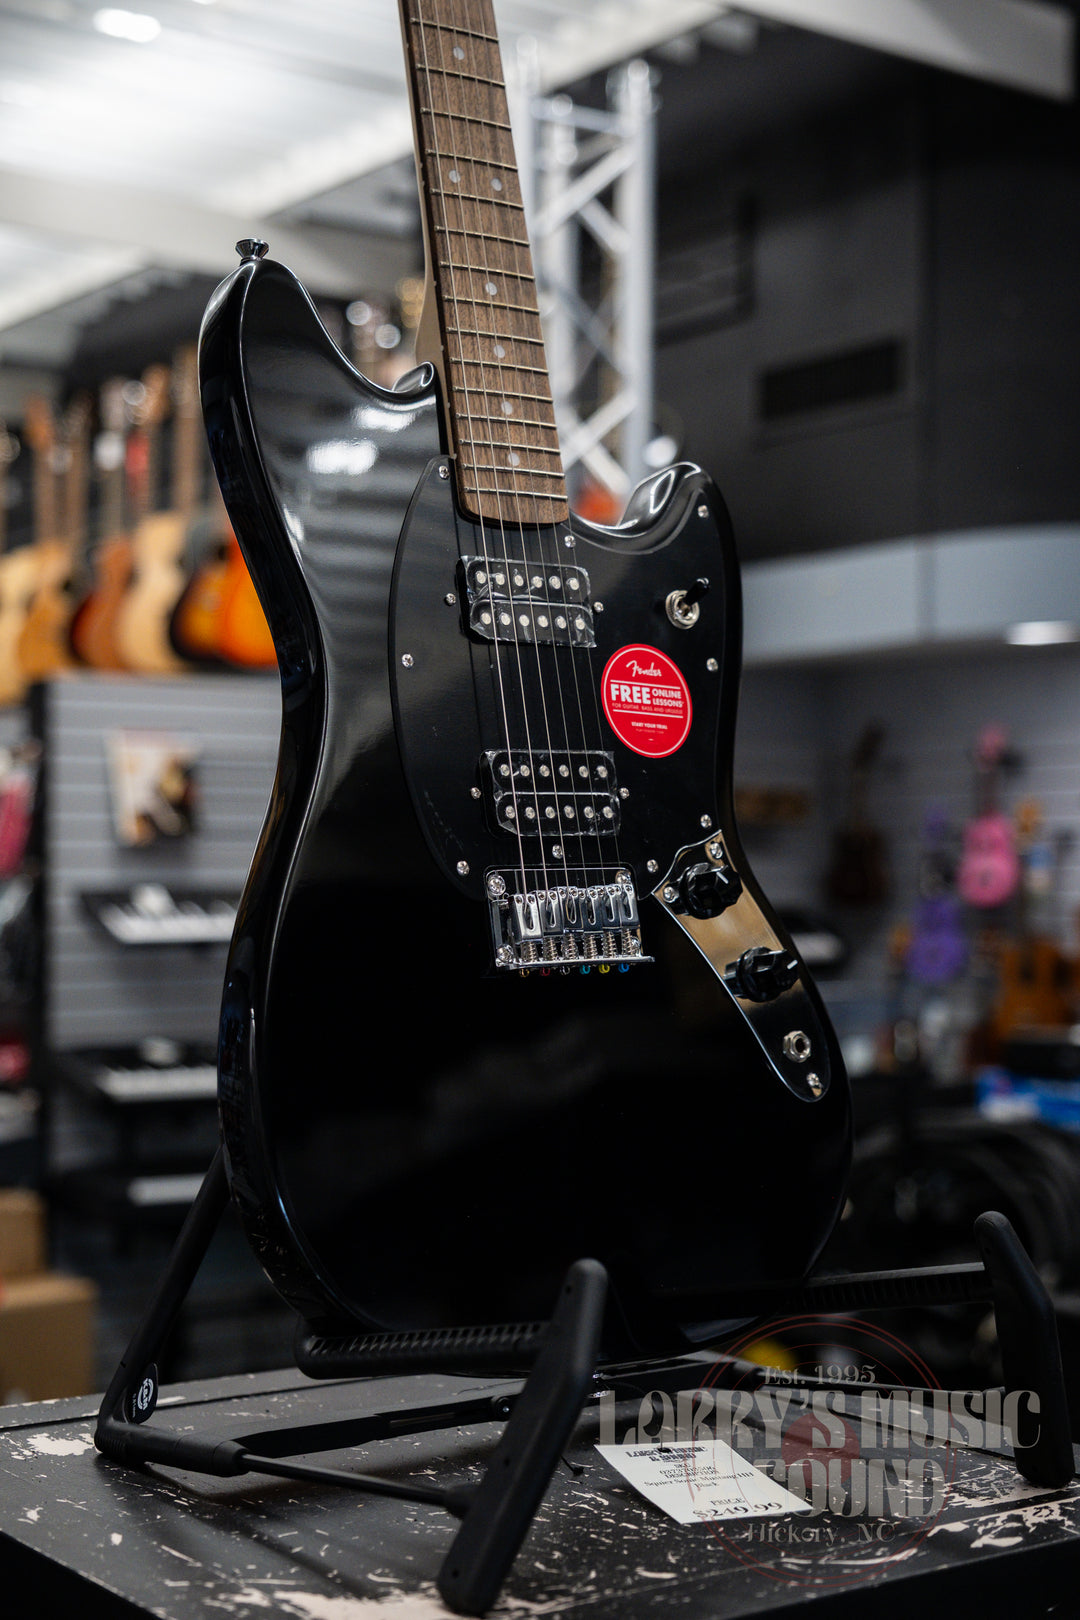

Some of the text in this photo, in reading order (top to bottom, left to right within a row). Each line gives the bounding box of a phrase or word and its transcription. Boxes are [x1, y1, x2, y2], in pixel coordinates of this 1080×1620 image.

[626, 660, 662, 677] Fender
[610, 684, 651, 704] FREE
[652, 688, 682, 699] ONLINE
[710, 1497, 745, 1506] PRICE
[693, 1502, 783, 1518] $249.99
